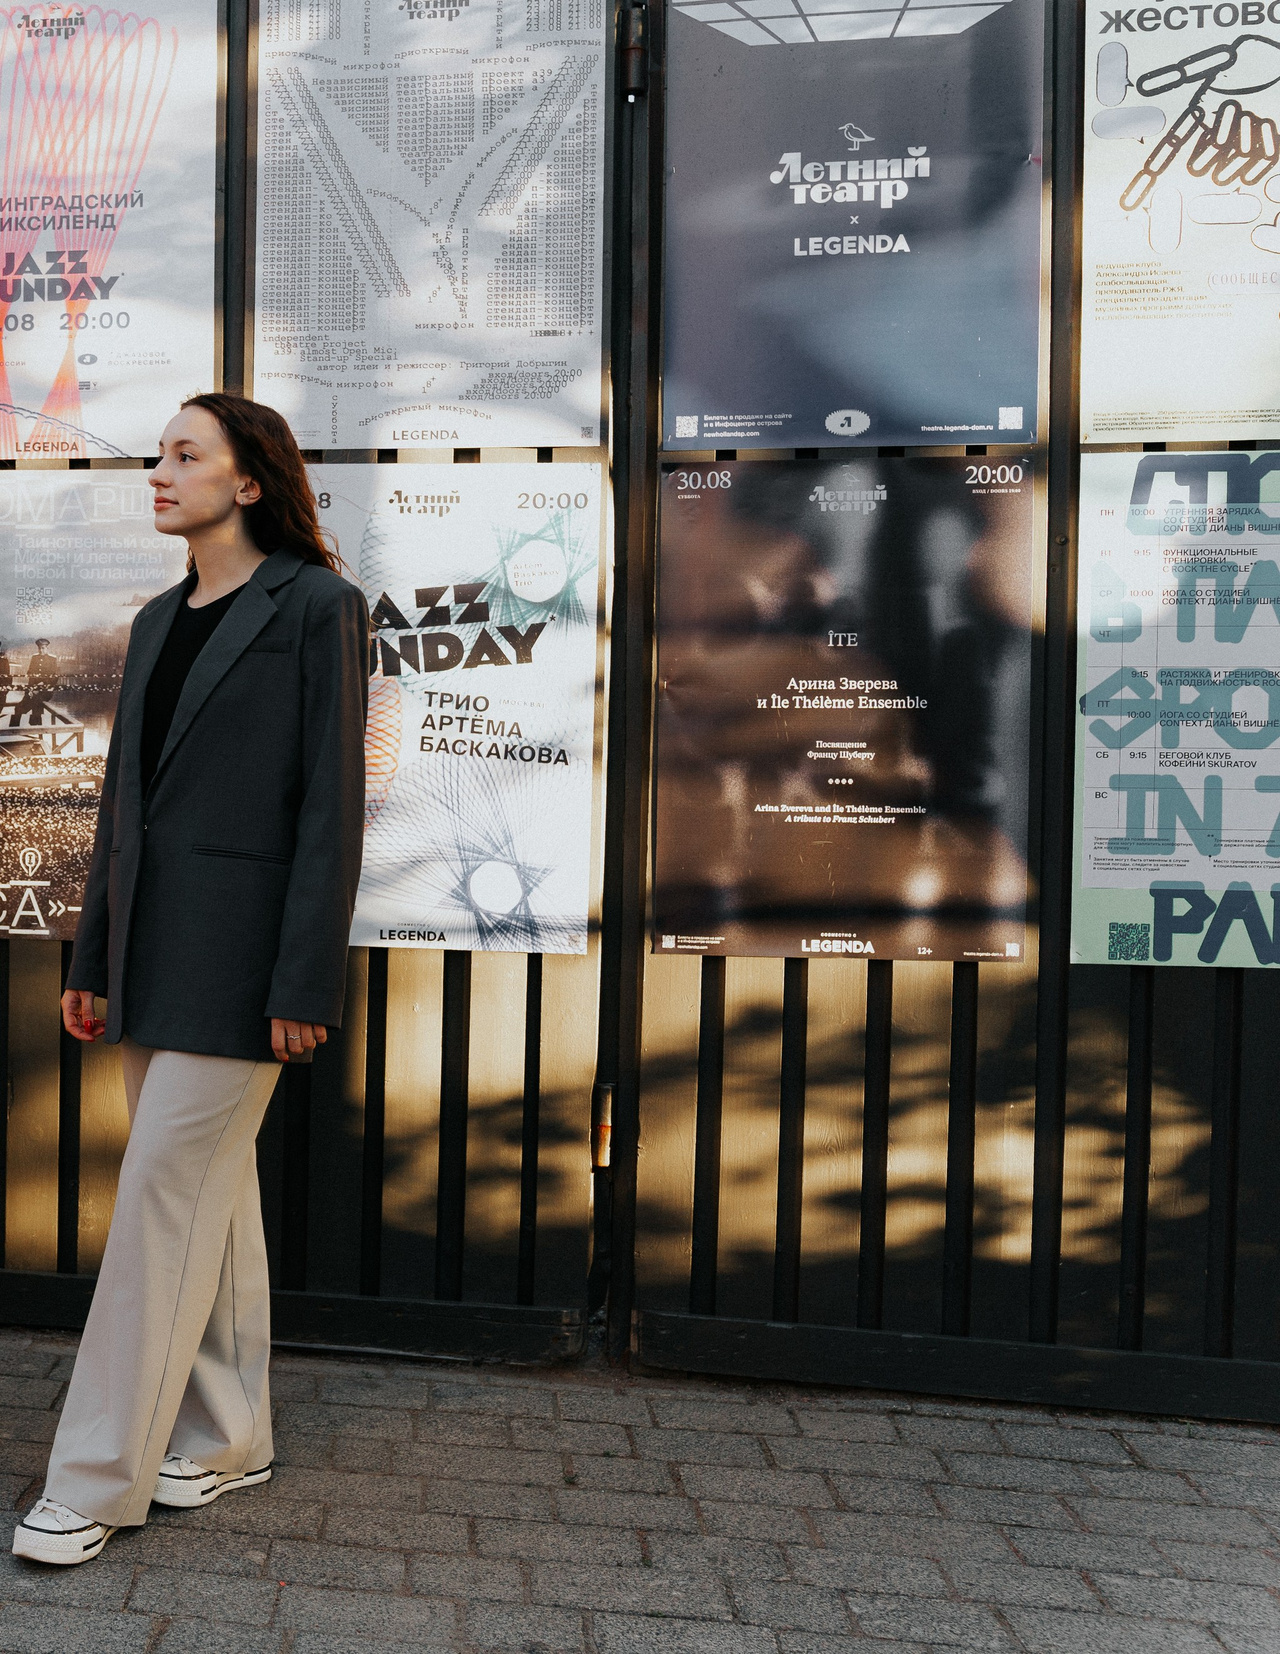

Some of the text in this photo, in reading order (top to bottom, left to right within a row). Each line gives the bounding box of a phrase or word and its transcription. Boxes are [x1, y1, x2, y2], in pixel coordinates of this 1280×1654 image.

[17, 12, 85, 29] Летний
[406, 8, 460, 22] театр
[26, 28, 76, 40] театр
[770, 146, 930, 184] Летний
[789, 179, 909, 209] театр
[794, 234, 911, 256] LEGENDA
[2, 250, 88, 276] JAZZ
[59, 312, 131, 331] 20:00
[262, 334, 330, 343] independent
[274, 340, 366, 350] theatre project
[337, 379, 394, 389] микрофон
[704, 430, 760, 439] newhollandsp.com
[921, 424, 994, 432] theatre.legenda-dom.ru
[393, 430, 459, 441] LEGENDA
[15, 441, 79, 453] LEGENDA
[677, 470, 732, 490] 30.08
[965, 465, 1023, 484] 20:00
[388, 490, 460, 504] Летний
[809, 484, 887, 502] Летний
[517, 492, 588, 509] 20:00
[399, 504, 451, 517] театр
[818, 501, 877, 515] театр
[1164, 507, 1261, 516] УТРЕННЯЯ ЗАРЯДКА
[1179, 515, 1224, 524] СТУДИЕЙ
[1162, 548, 1258, 556] ФУНКЦИОНАЛЬНЫЕ
[827, 630, 858, 647] ÎTE
[1160, 671, 1211, 679] РАСТЯЖКА
[787, 677, 898, 693] Арина Зверева
[1179, 679, 1251, 688] ПОДВИЖНОСТЬ
[424, 690, 490, 713] ТРИО
[793, 695, 928, 709] Thélème Ensemble
[1127, 711, 1151, 719] 10:00
[1202, 710, 1247, 719] СТУДИЕЙ
[421, 713, 523, 739] АРТЁМА
[419, 735, 569, 766] БАСКАКОВА
[816, 740, 867, 750] Посвящение
[840, 751, 875, 760] Шуберту
[1129, 751, 1147, 759] 9:15
[1159, 751, 1231, 760] БЕГОВОЙ КЛУБ
[1159, 759, 1257, 768] КОФЕЙНИ SKURATOV
[885, 805, 926, 814] Ensemble
[379, 929, 447, 942] LEGENDA
[801, 939, 875, 954] LEGENDA
